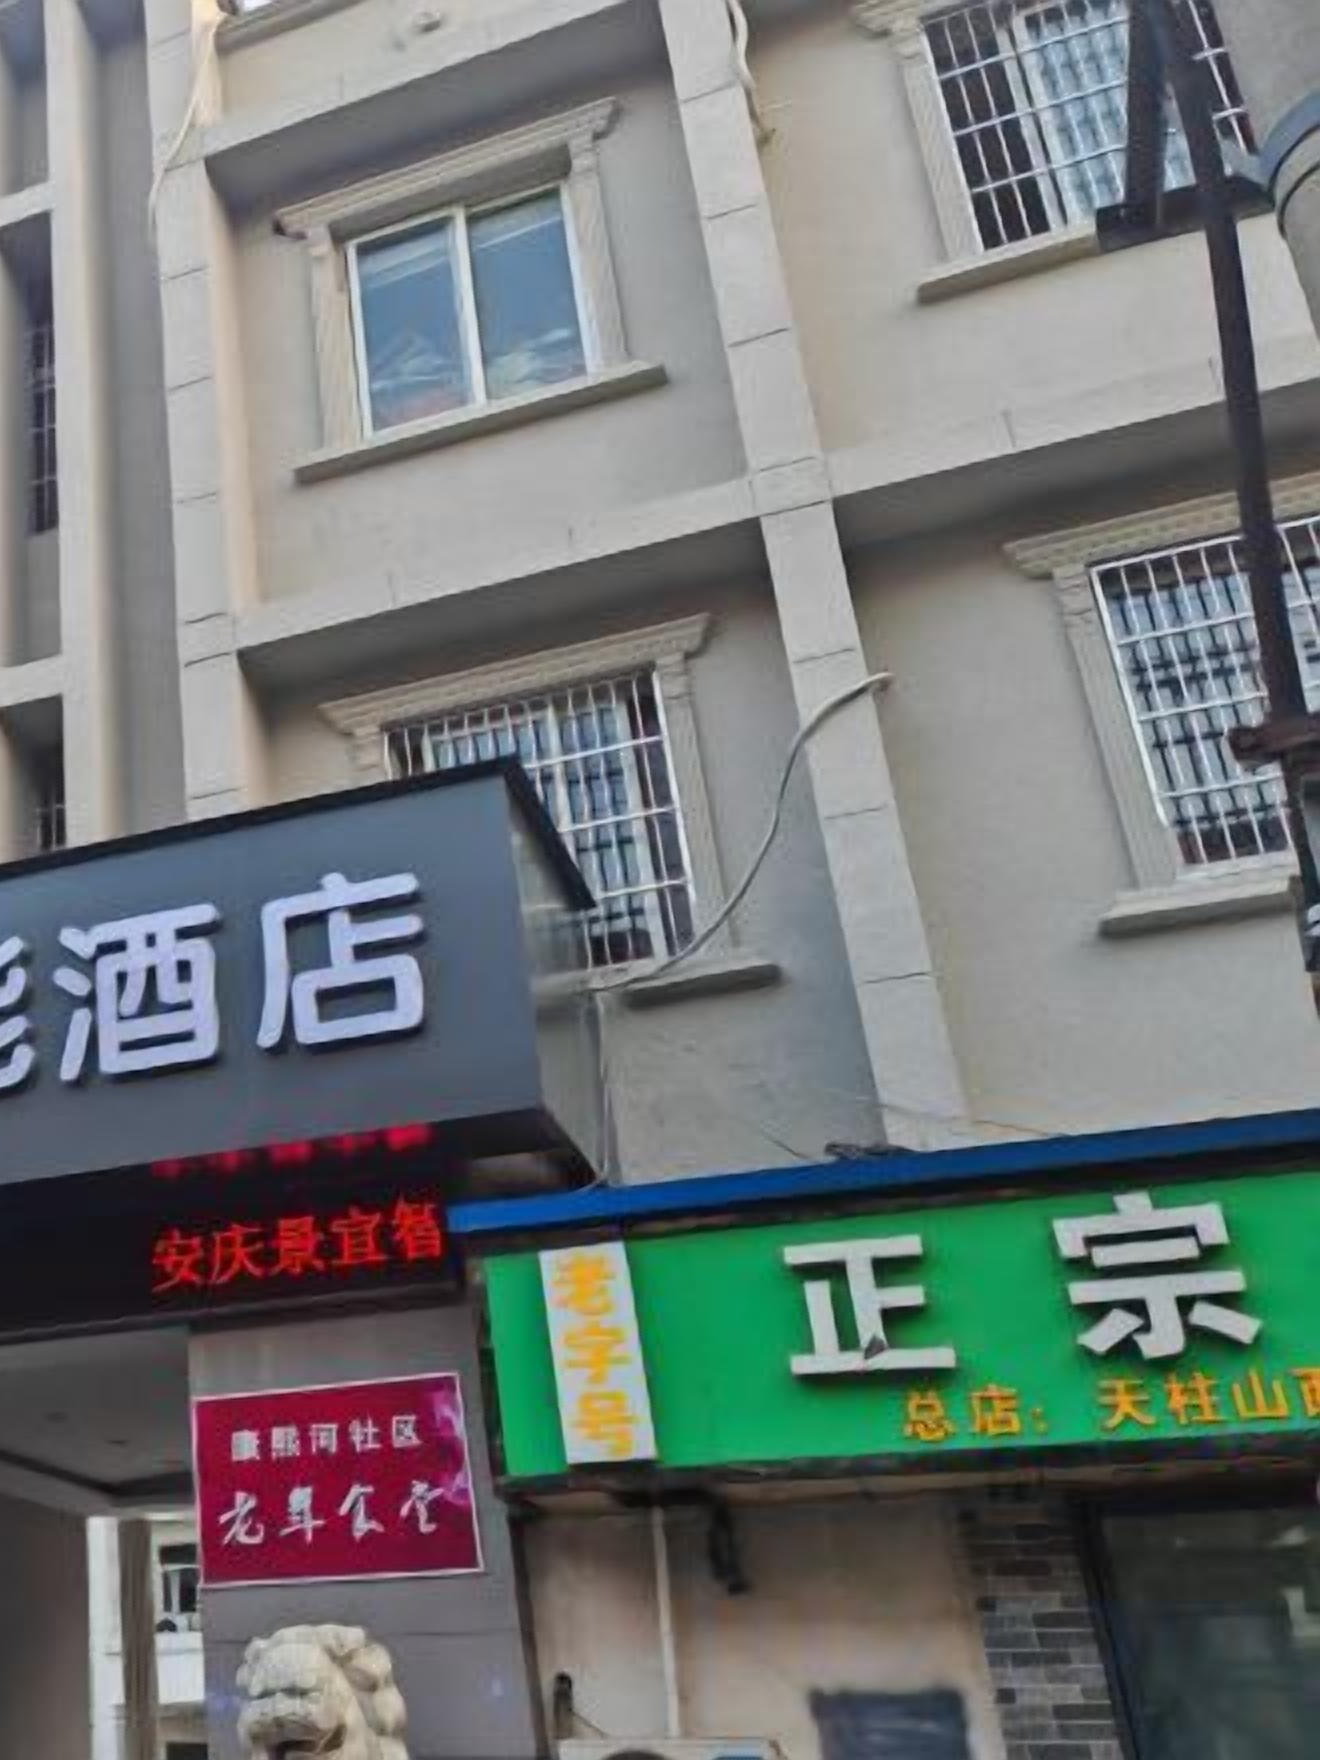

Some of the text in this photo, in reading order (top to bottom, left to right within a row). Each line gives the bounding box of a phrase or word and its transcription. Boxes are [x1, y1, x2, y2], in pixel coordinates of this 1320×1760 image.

[152, 1197, 442, 1292] 安庆景宜智
[782, 1191, 1264, 1378] 正宗
[552, 1253, 639, 1457] 老字号
